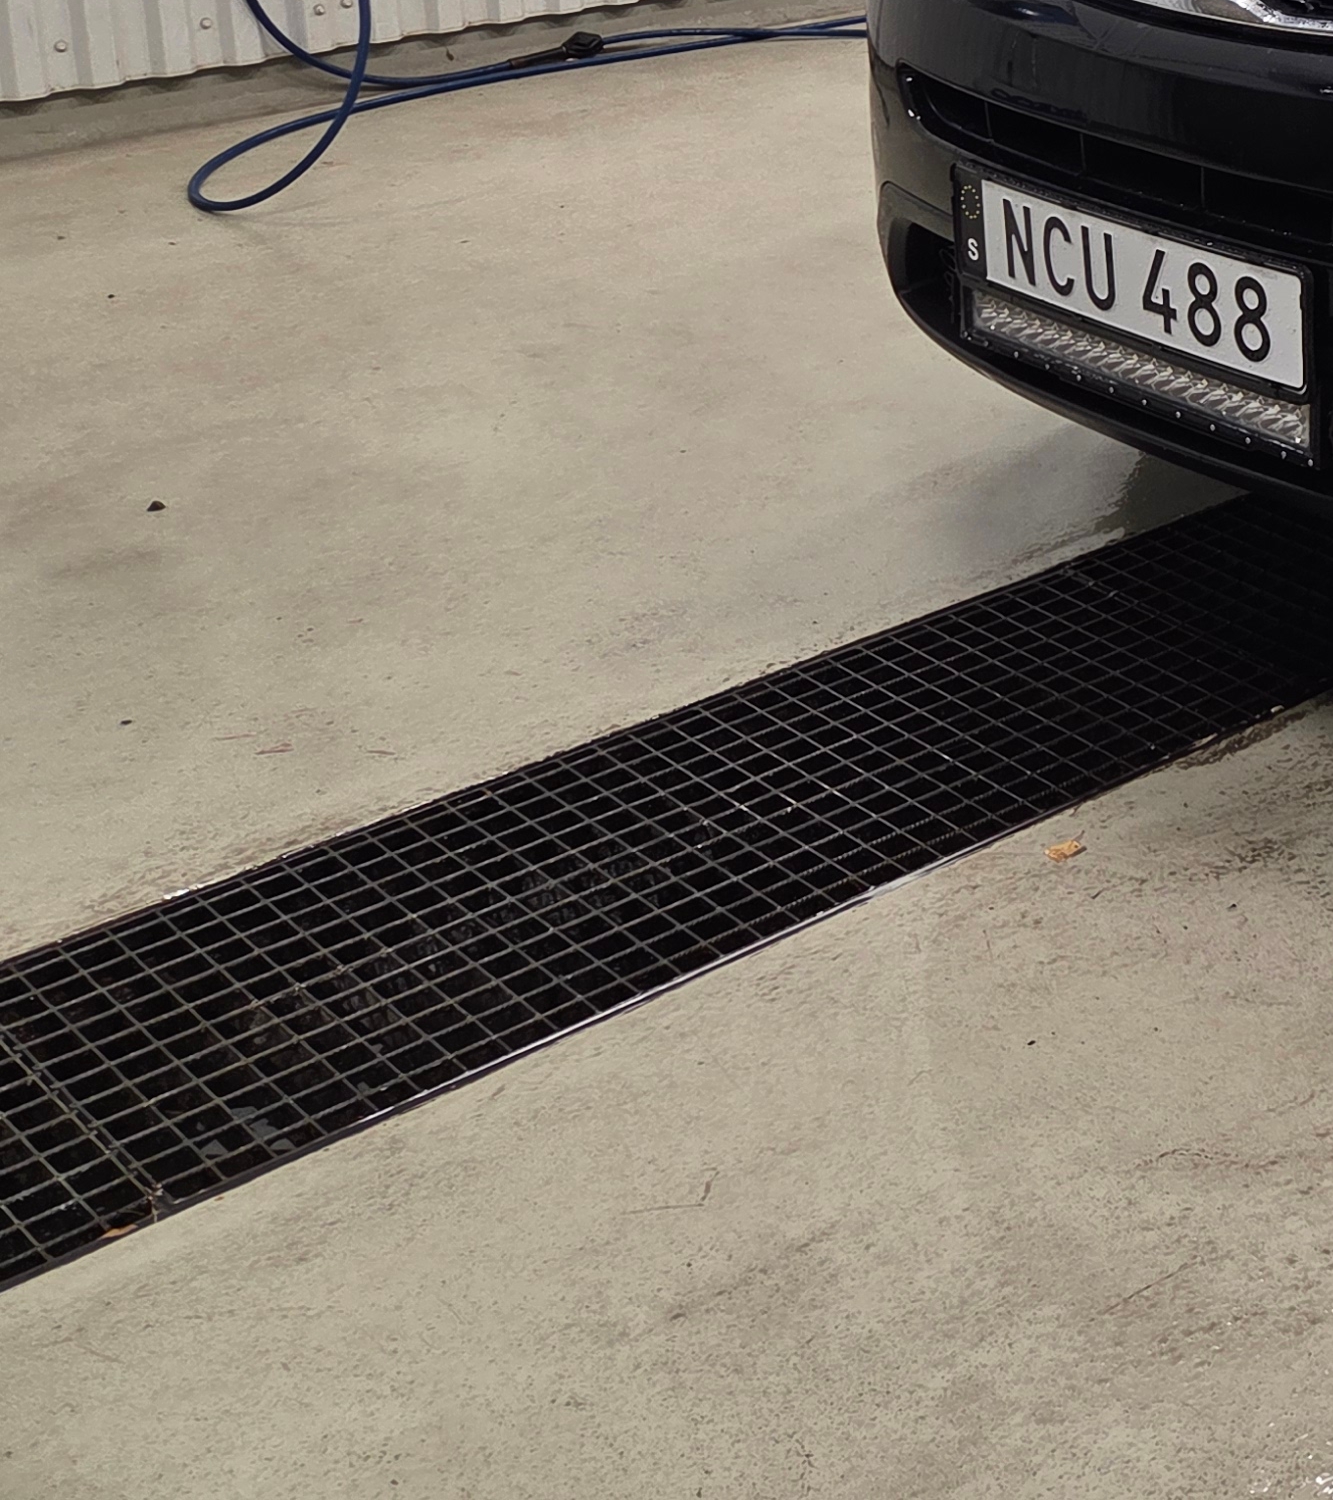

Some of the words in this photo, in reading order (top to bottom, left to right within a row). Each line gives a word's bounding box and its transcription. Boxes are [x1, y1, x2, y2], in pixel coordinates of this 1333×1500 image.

[966, 236, 980, 262] S
[1001, 197, 1117, 312] NCU
[1142, 248, 1272, 363] 488
